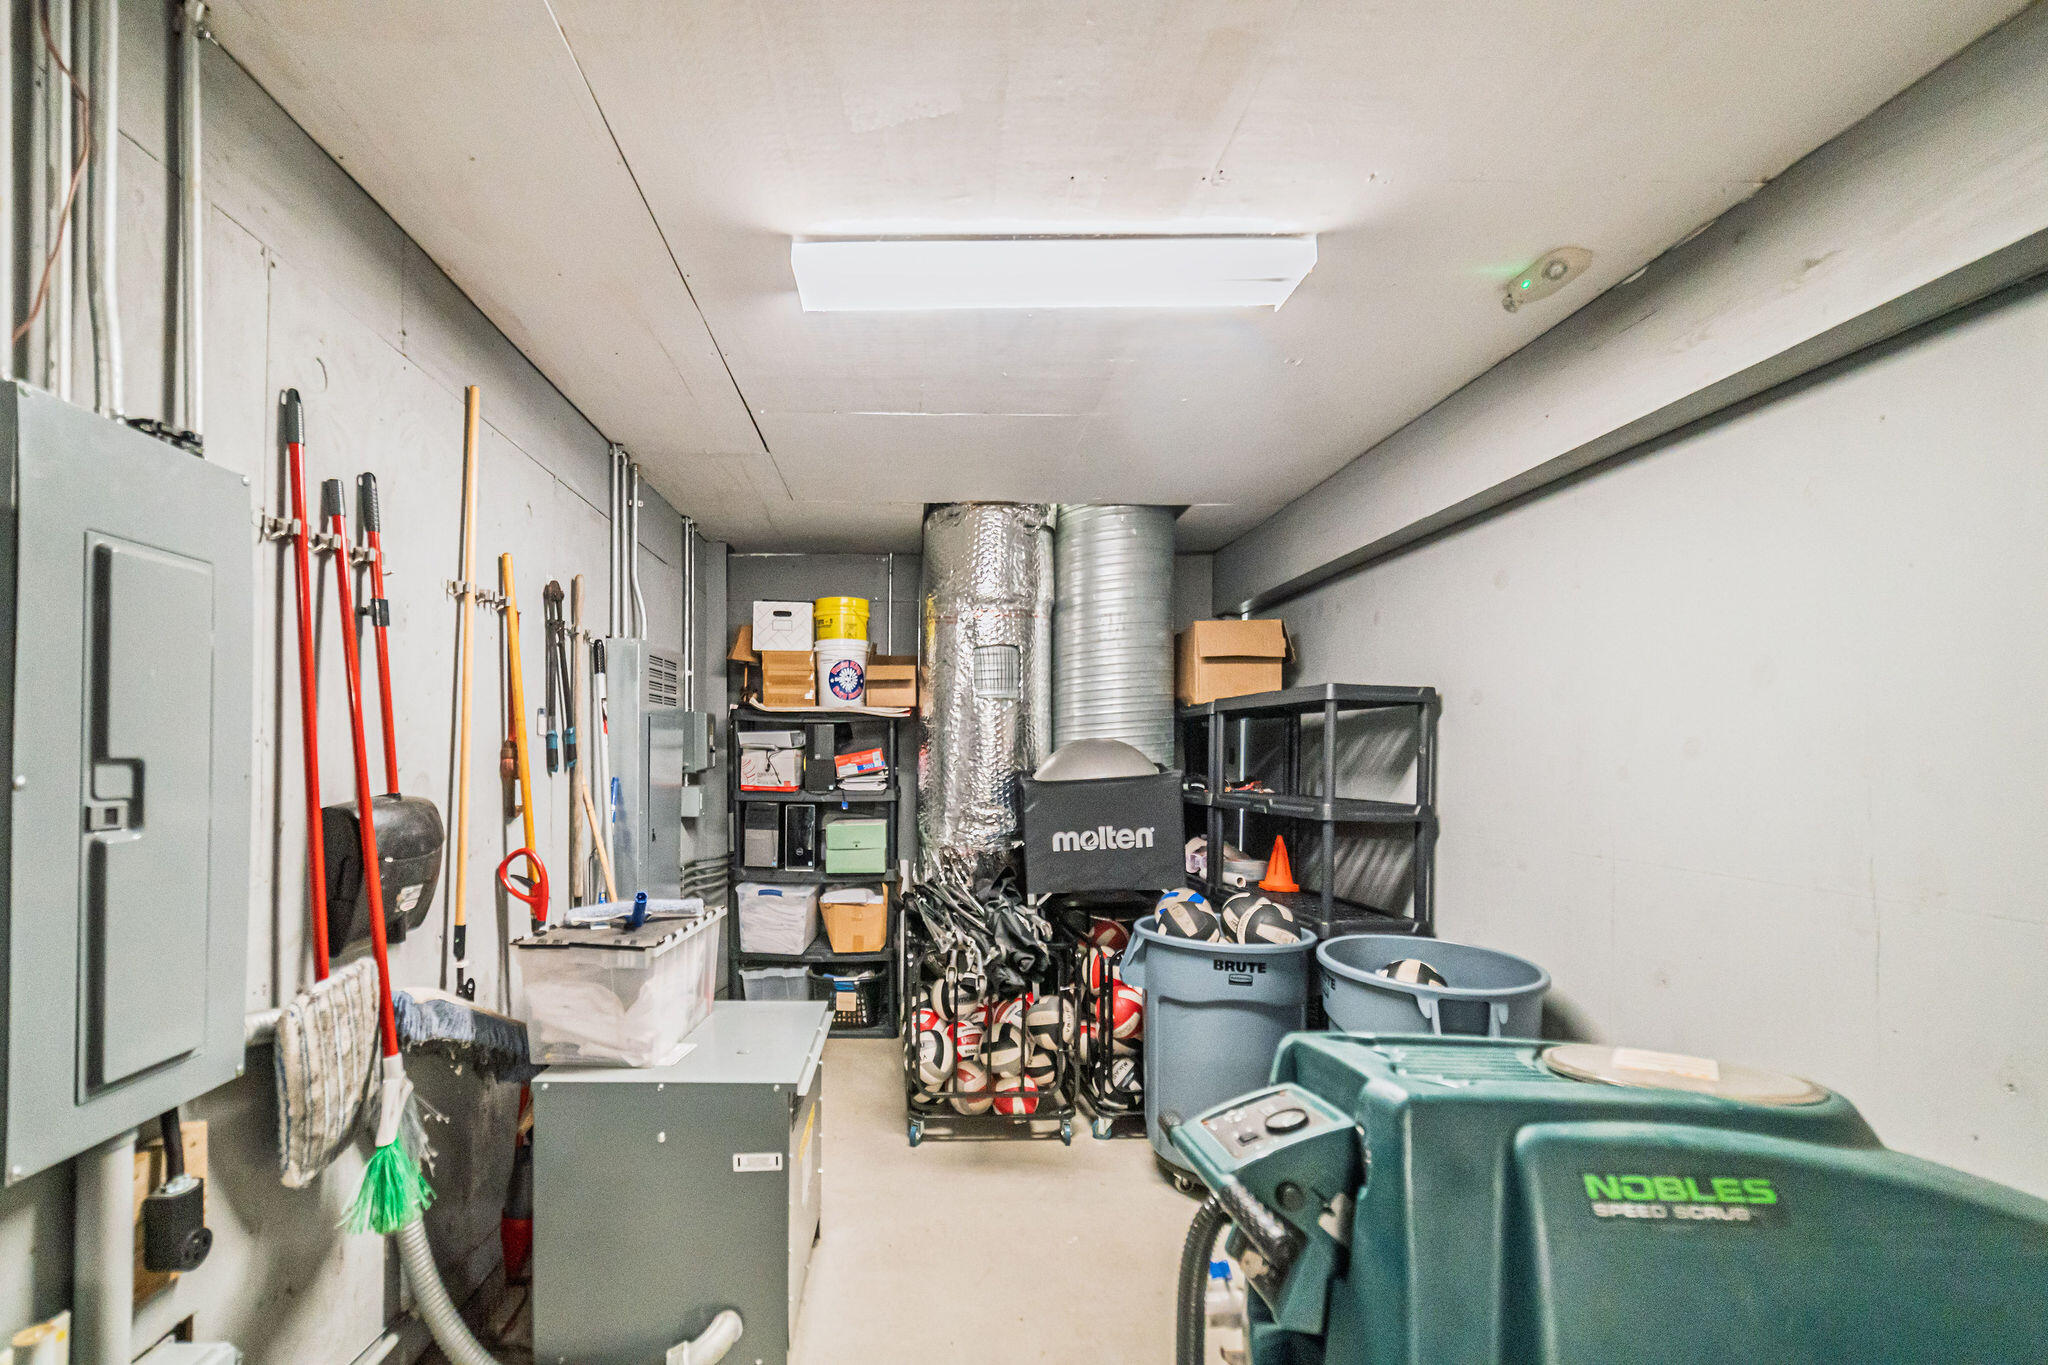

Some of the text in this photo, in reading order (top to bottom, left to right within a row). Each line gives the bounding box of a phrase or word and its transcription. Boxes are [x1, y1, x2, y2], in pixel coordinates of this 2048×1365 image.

[1052, 826, 1154, 852] molten
[1213, 959, 1267, 973] BRUTE
[1583, 1173, 1777, 1204] NOBLES
